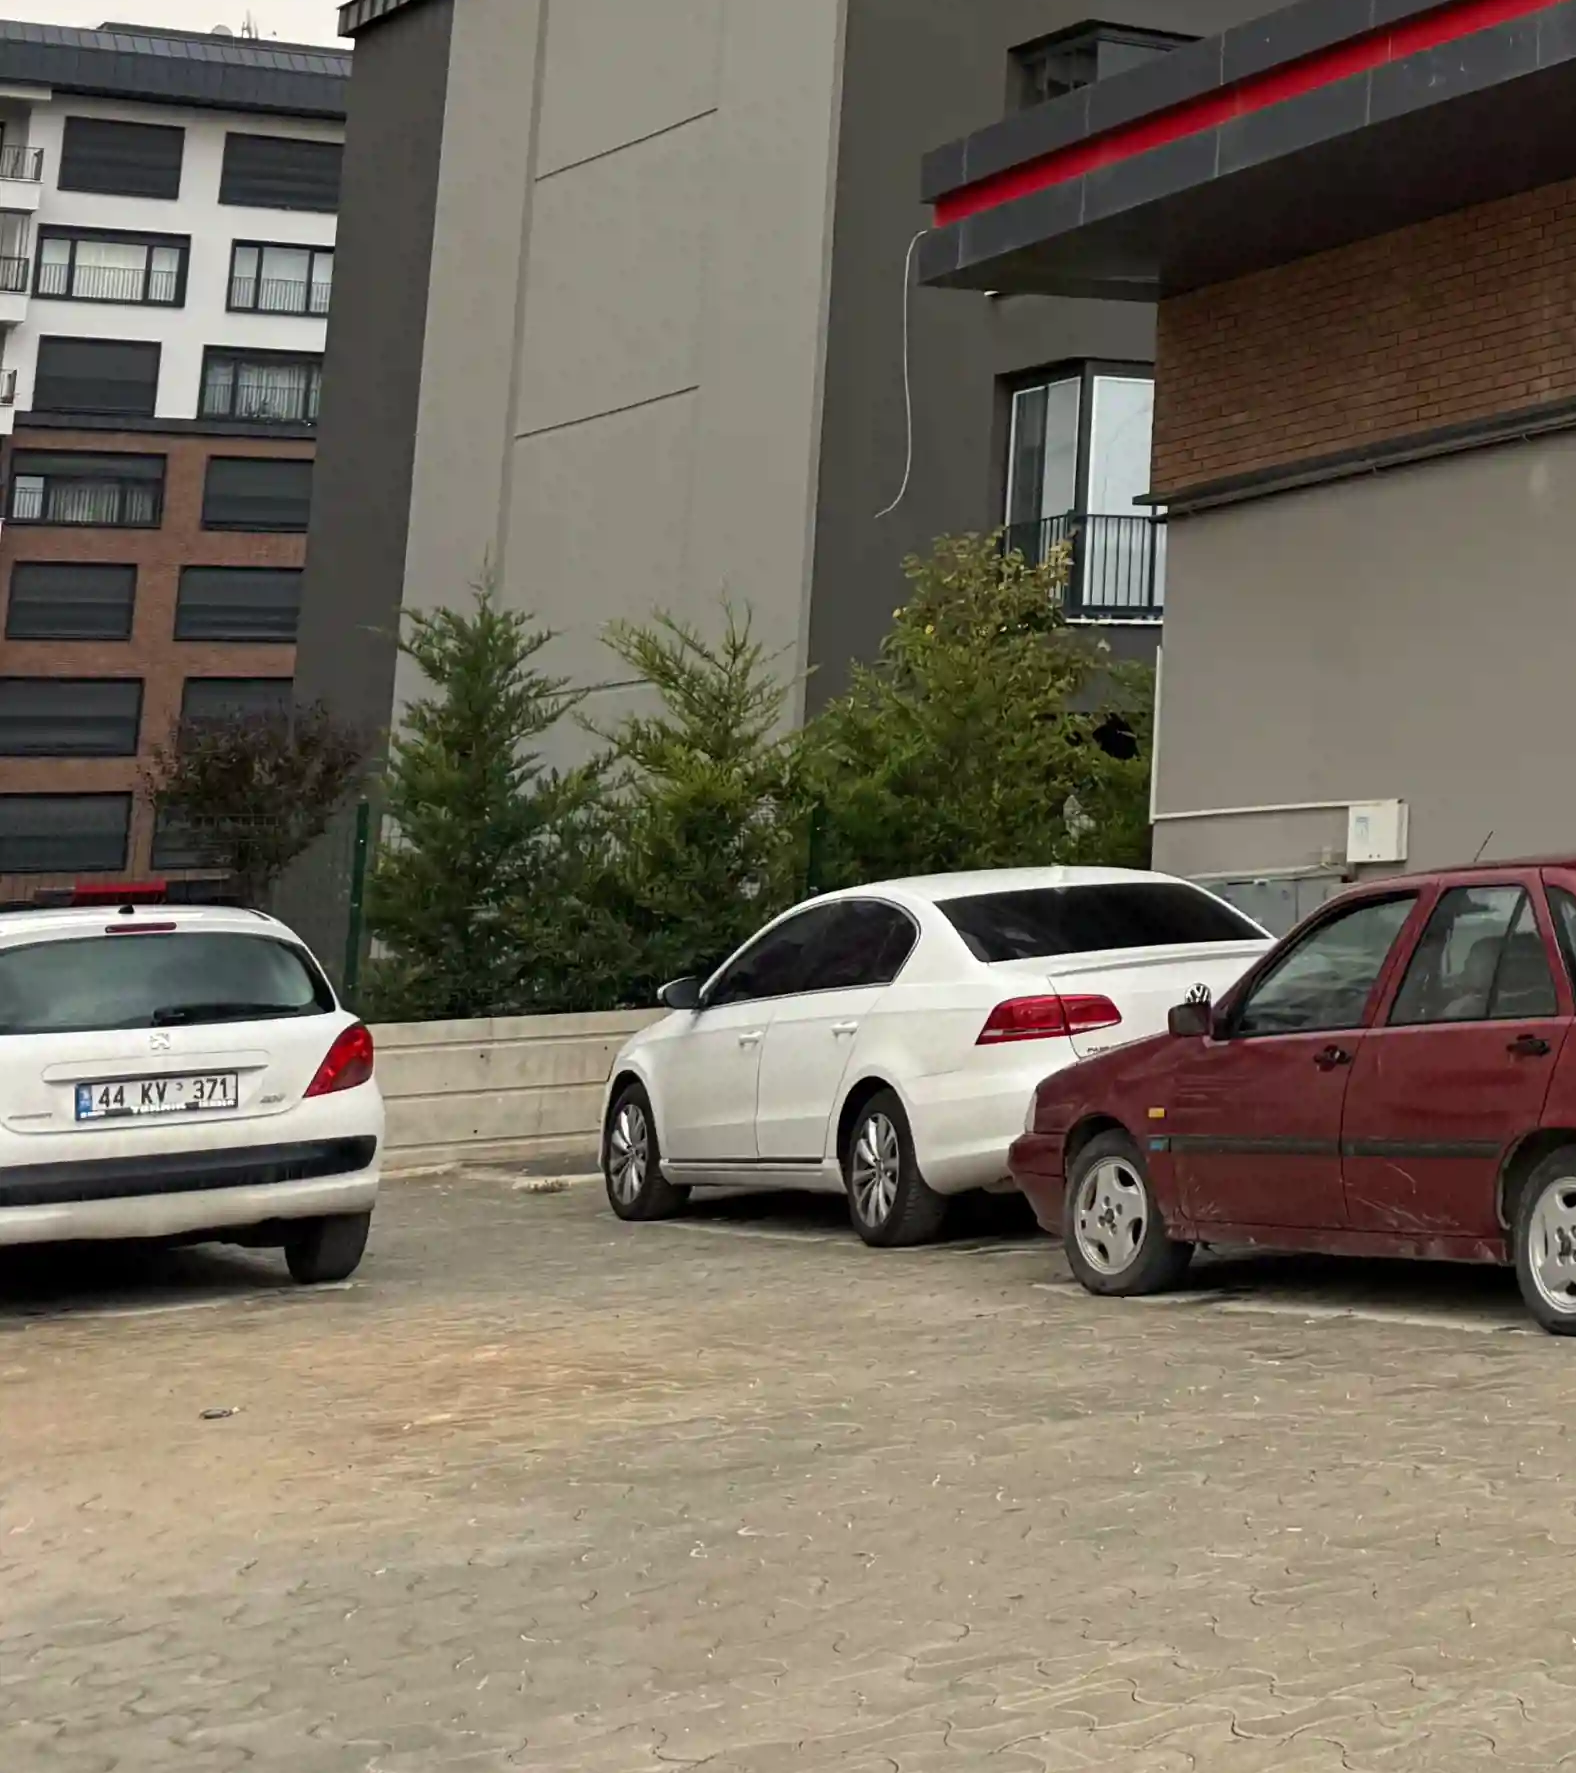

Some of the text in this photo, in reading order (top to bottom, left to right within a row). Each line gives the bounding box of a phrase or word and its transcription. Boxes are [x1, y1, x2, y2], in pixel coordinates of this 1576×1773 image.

[98, 1077, 229, 1108] 44 KV 371
